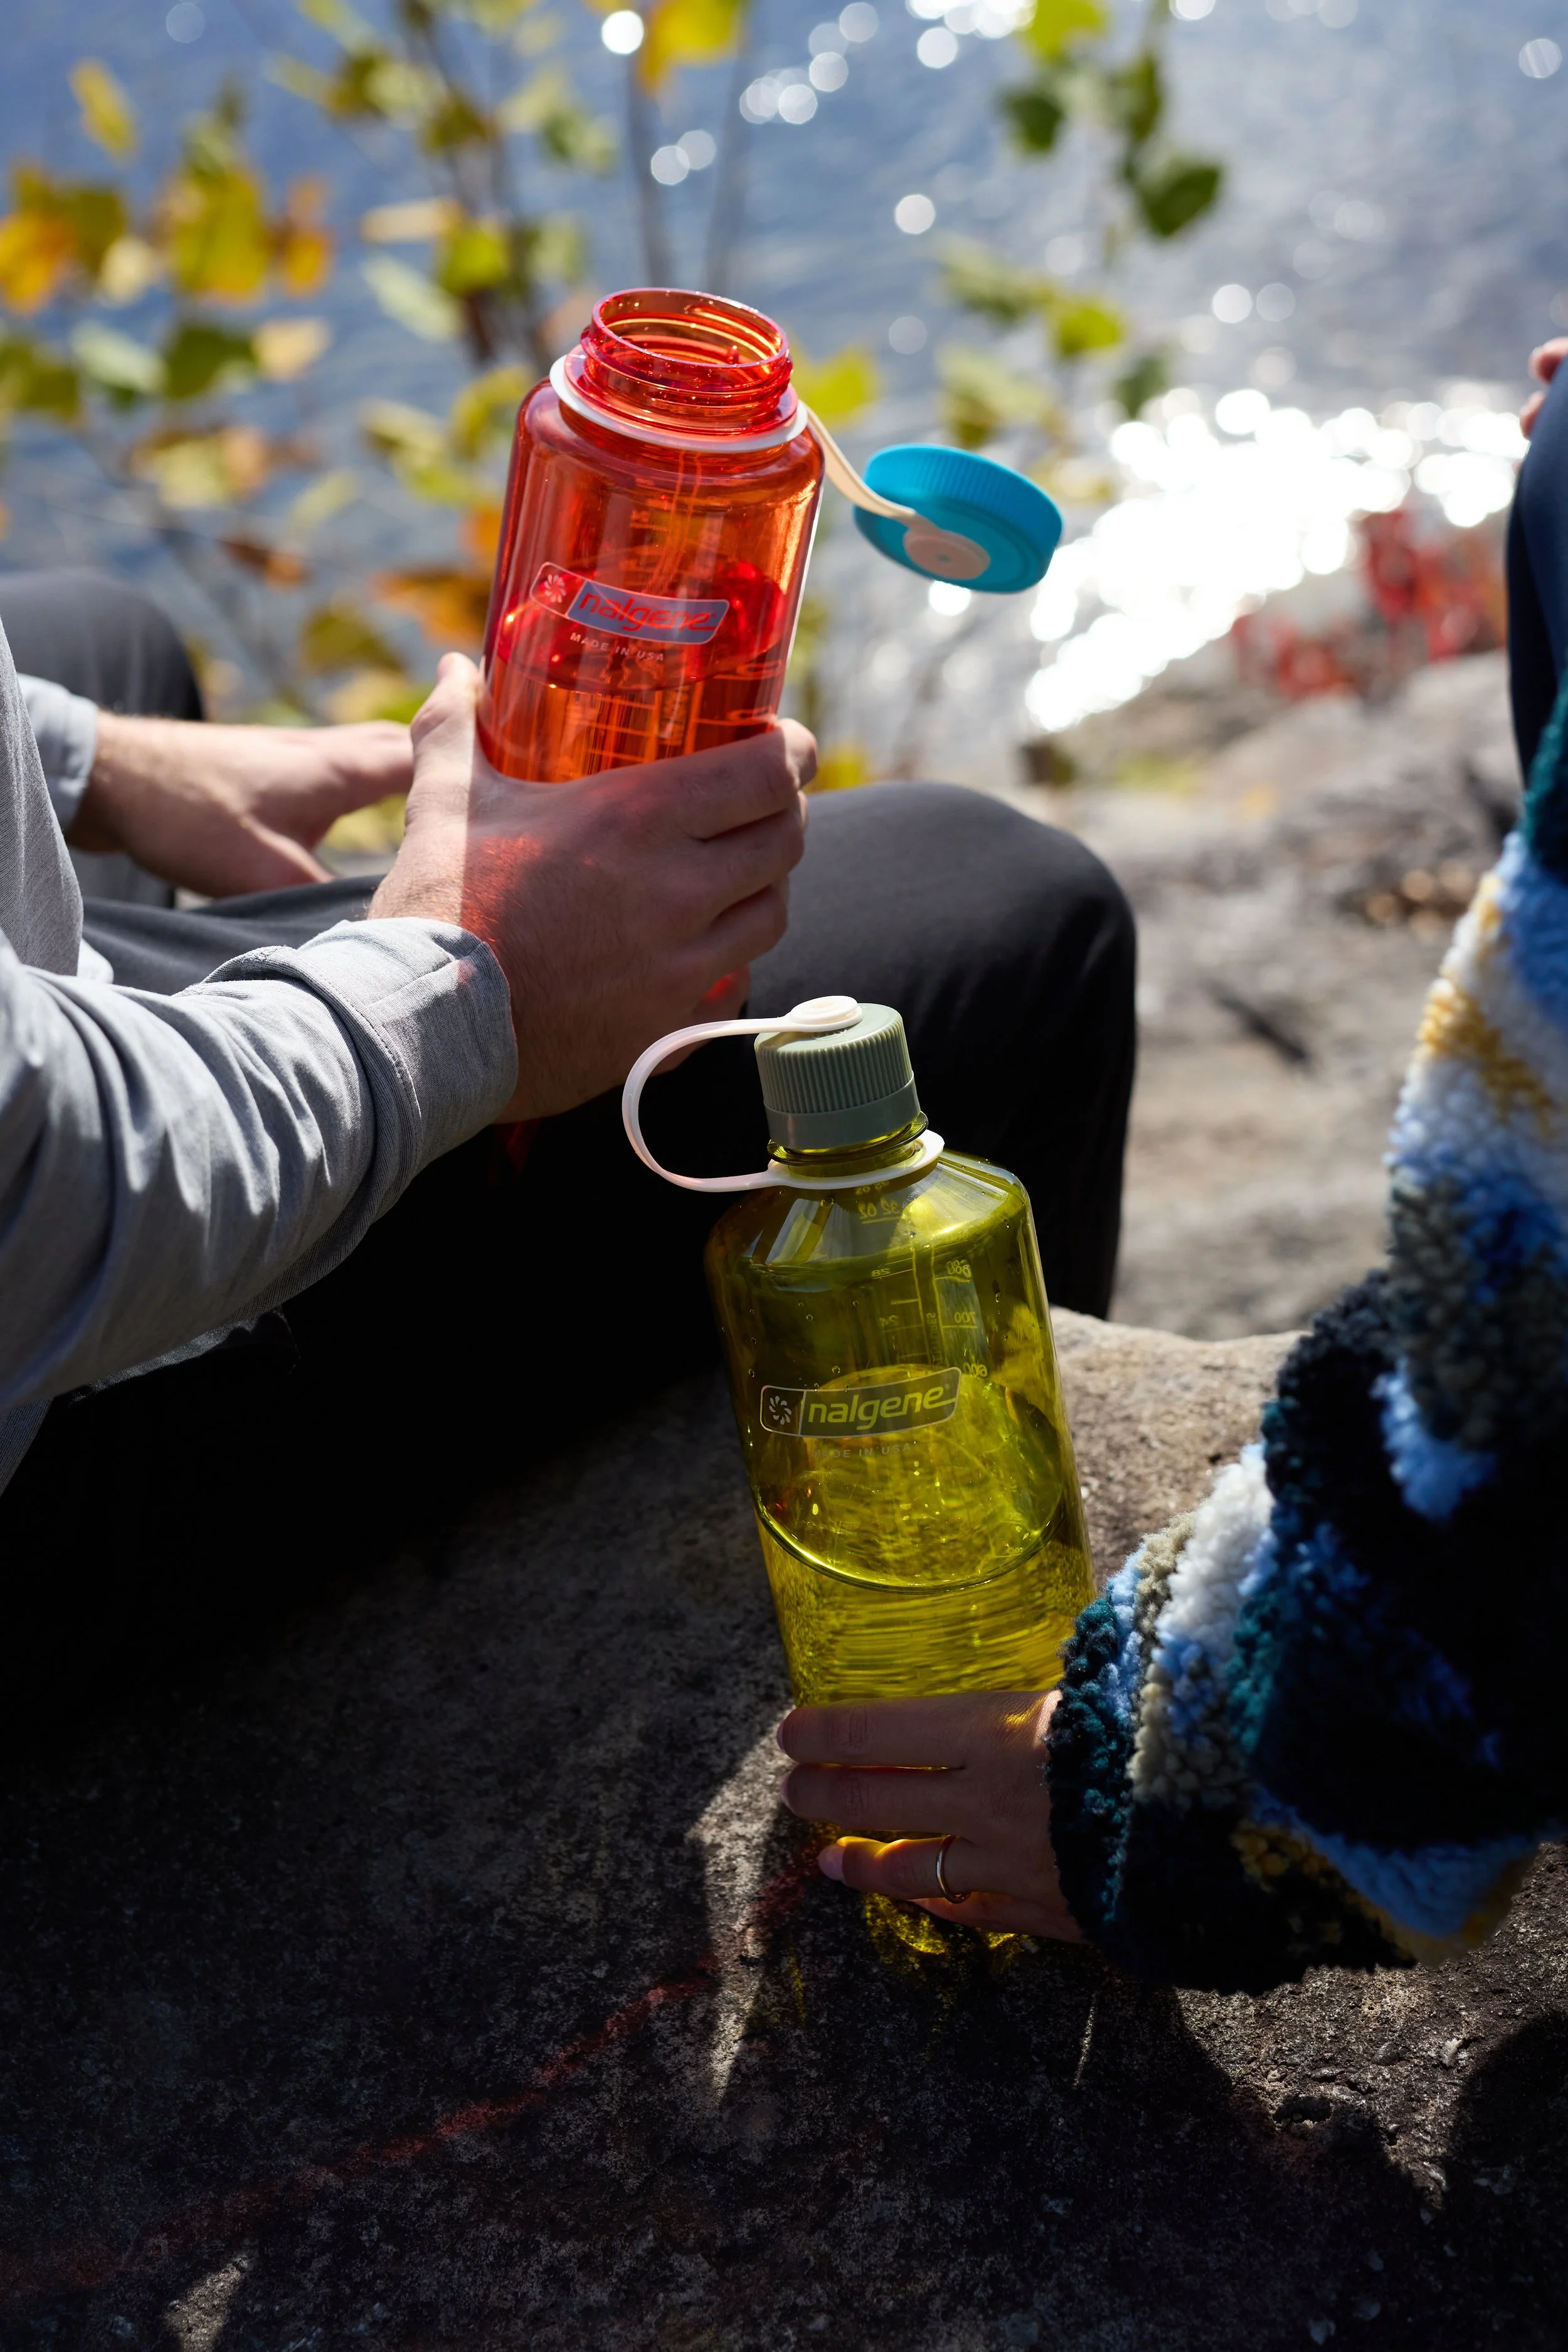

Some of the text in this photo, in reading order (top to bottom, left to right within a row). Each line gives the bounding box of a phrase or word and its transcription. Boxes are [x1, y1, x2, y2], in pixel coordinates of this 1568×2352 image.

[579, 593, 717, 632] nalgene
[569, 632, 664, 661] MADE IN USA
[807, 1386, 956, 1430] nalgene
[812, 1442, 911, 1459] MADE IN USA
